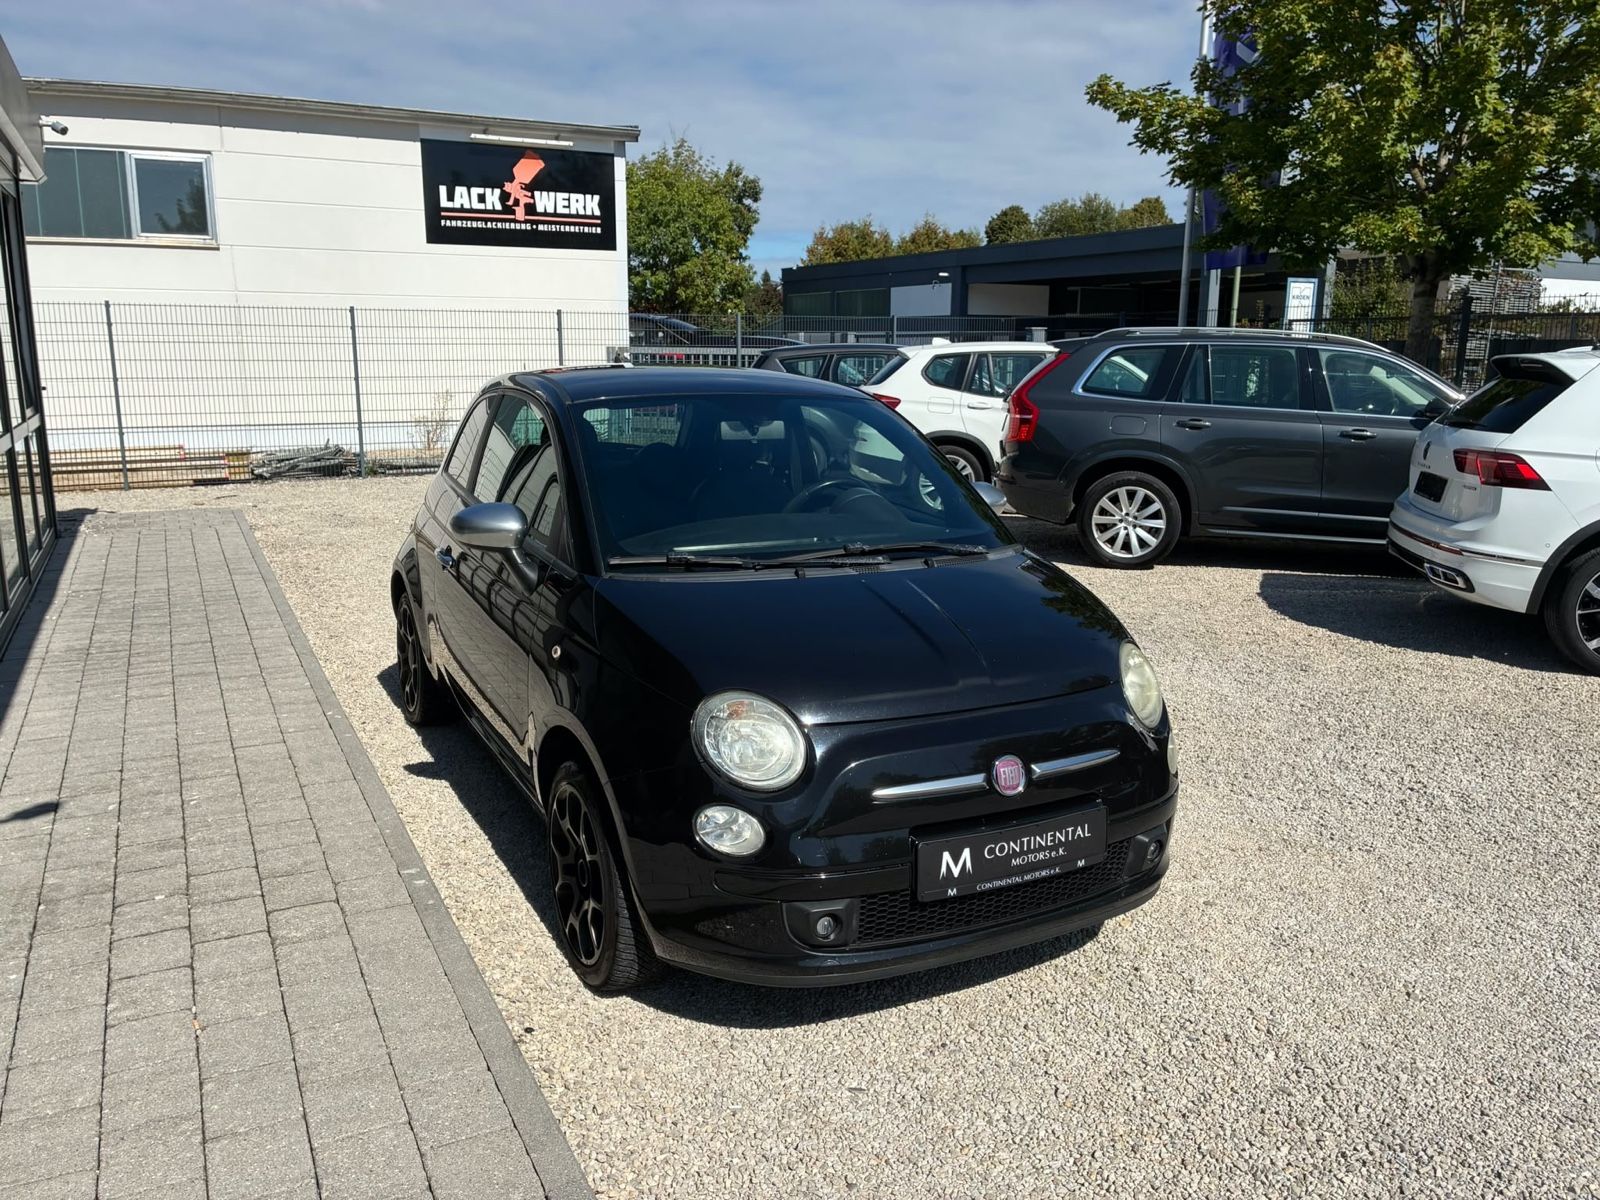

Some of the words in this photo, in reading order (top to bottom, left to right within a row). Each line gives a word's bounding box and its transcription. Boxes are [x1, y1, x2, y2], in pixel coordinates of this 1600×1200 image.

[438, 184, 503, 210] LACK
[533, 190, 601, 216] WERK
[440, 219, 532, 230] FAHRZEUGLACKIERUNG
[537, 224, 602, 234] MEISTERBETRIEB
[983, 823, 1092, 859] CONTINENTAL
[939, 847, 973, 880] M
[1010, 850, 1050, 867] MOTORS
[976, 876, 1023, 891] CONTINENTAL
[1023, 868, 1050, 881] MOTORS
